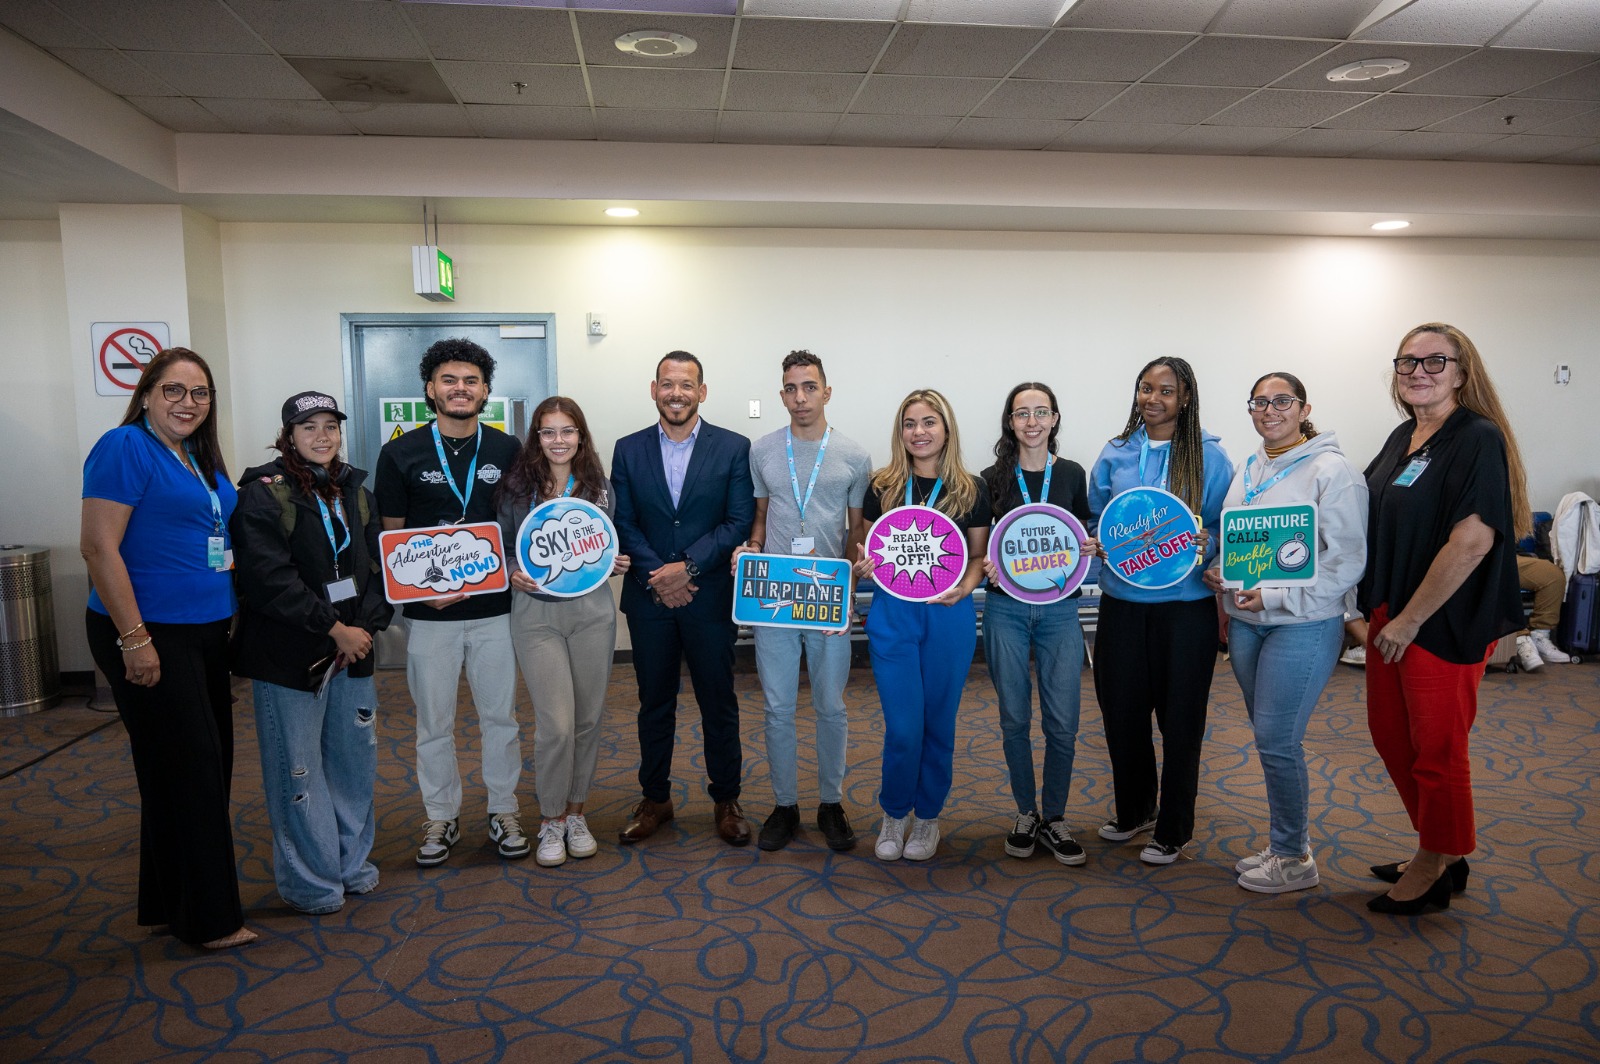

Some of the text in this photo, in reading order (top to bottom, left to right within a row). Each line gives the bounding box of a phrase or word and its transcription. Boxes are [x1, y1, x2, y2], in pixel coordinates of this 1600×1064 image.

[572, 524, 595, 540] IS THE
[1020, 525, 1056, 538] FUTURE
[1108, 505, 1169, 540] Ready for
[1227, 513, 1309, 532] ADVENTURE
[411, 538, 433, 550] THE
[535, 527, 571, 559] SKY
[570, 532, 605, 557] LIMIT
[892, 533, 929, 543] READY
[901, 542, 931, 553] take
[1004, 535, 1075, 556] GLOBAL
[1227, 531, 1270, 544] CALLS
[392, 542, 462, 569] Adventure
[441, 549, 480, 569] begins
[895, 553, 935, 566] OFF!!
[1013, 552, 1069, 573] LEADER
[1117, 548, 1161, 577] TAKE
[1225, 543, 1273, 568] Buckle
[449, 556, 496, 582] NOW!
[747, 561, 768, 577] IN
[1247, 556, 1273, 579] Up!
[743, 580, 842, 603] AIRPLANE
[792, 603, 841, 622] MODE
